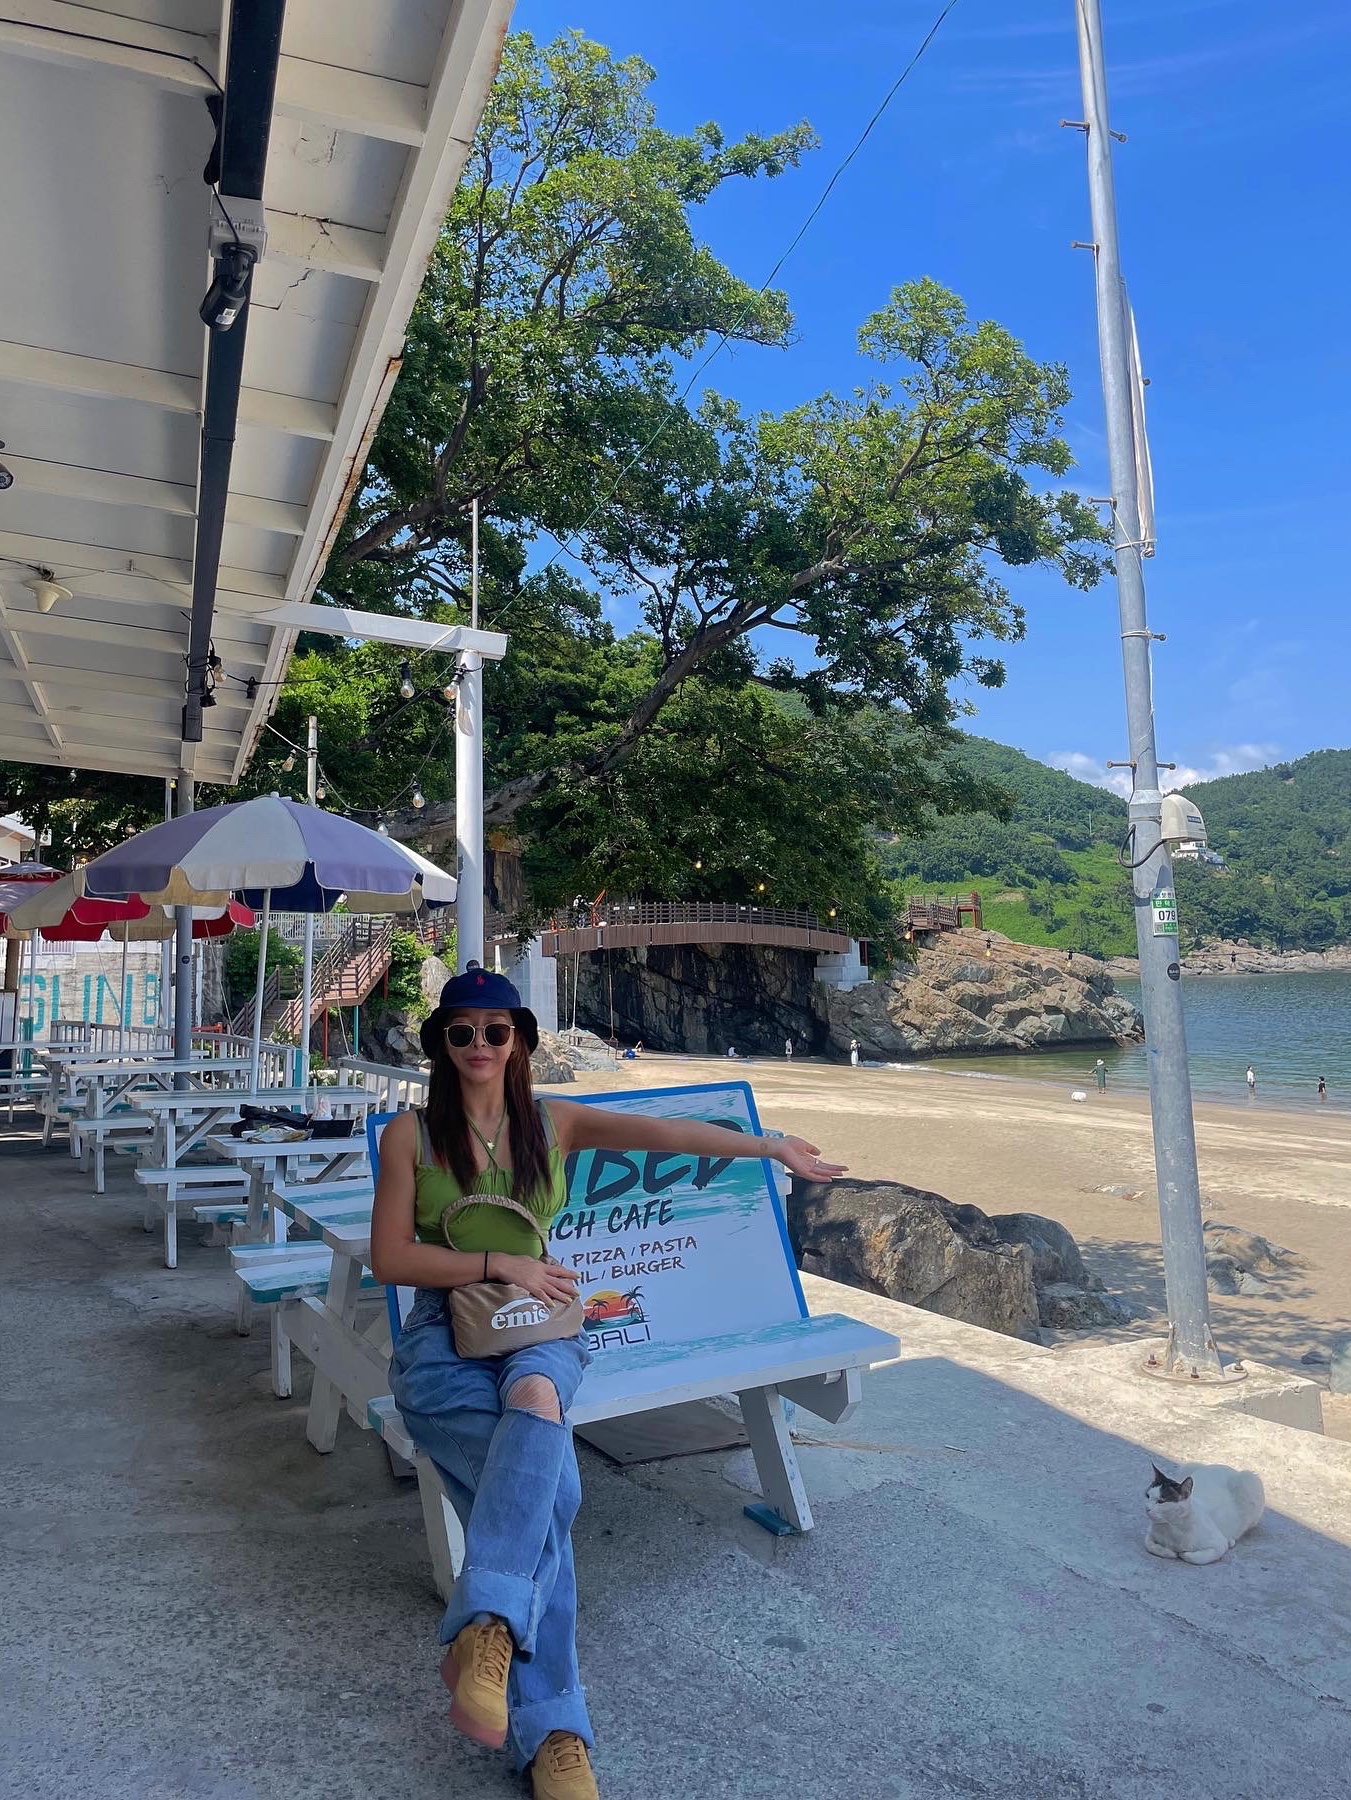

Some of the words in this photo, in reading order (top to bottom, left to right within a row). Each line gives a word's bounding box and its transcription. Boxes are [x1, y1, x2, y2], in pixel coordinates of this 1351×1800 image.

[608, 1199, 674, 1234] CAFE
[571, 1247, 626, 1267] PIZZA
[639, 1236, 698, 1257] PASTA
[611, 1256, 686, 1280] BURGER
[491, 1305, 551, 1330] emis
[588, 1324, 652, 1352] BALI
